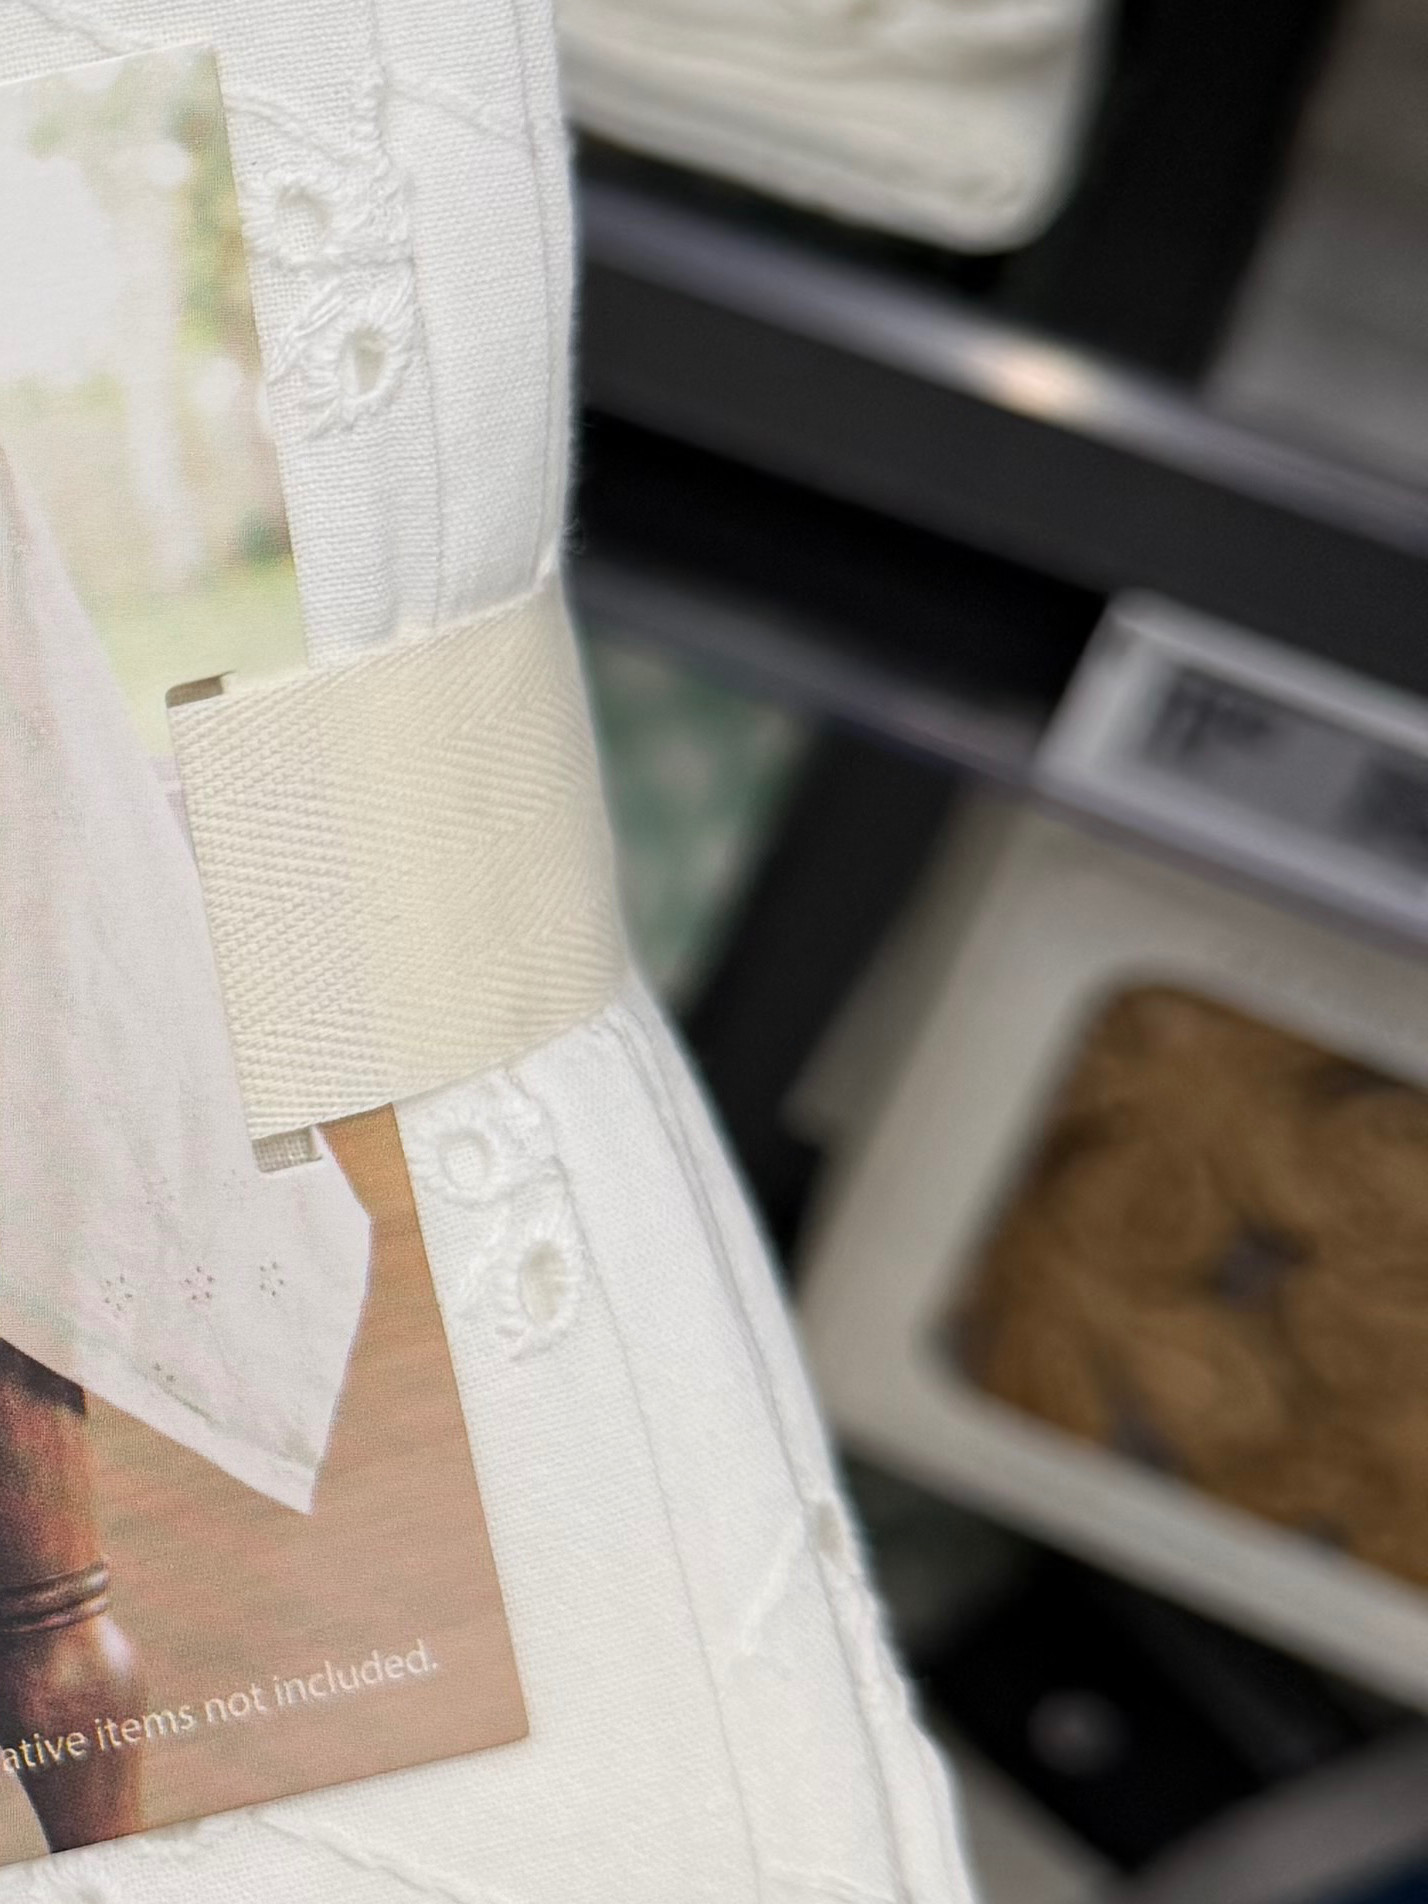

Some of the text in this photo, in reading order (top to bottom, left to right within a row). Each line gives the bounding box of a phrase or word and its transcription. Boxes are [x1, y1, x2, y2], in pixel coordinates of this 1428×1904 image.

[93, 1701, 196, 1752] items
[206, 1682, 269, 1723] not
[273, 1639, 439, 1707] included.
